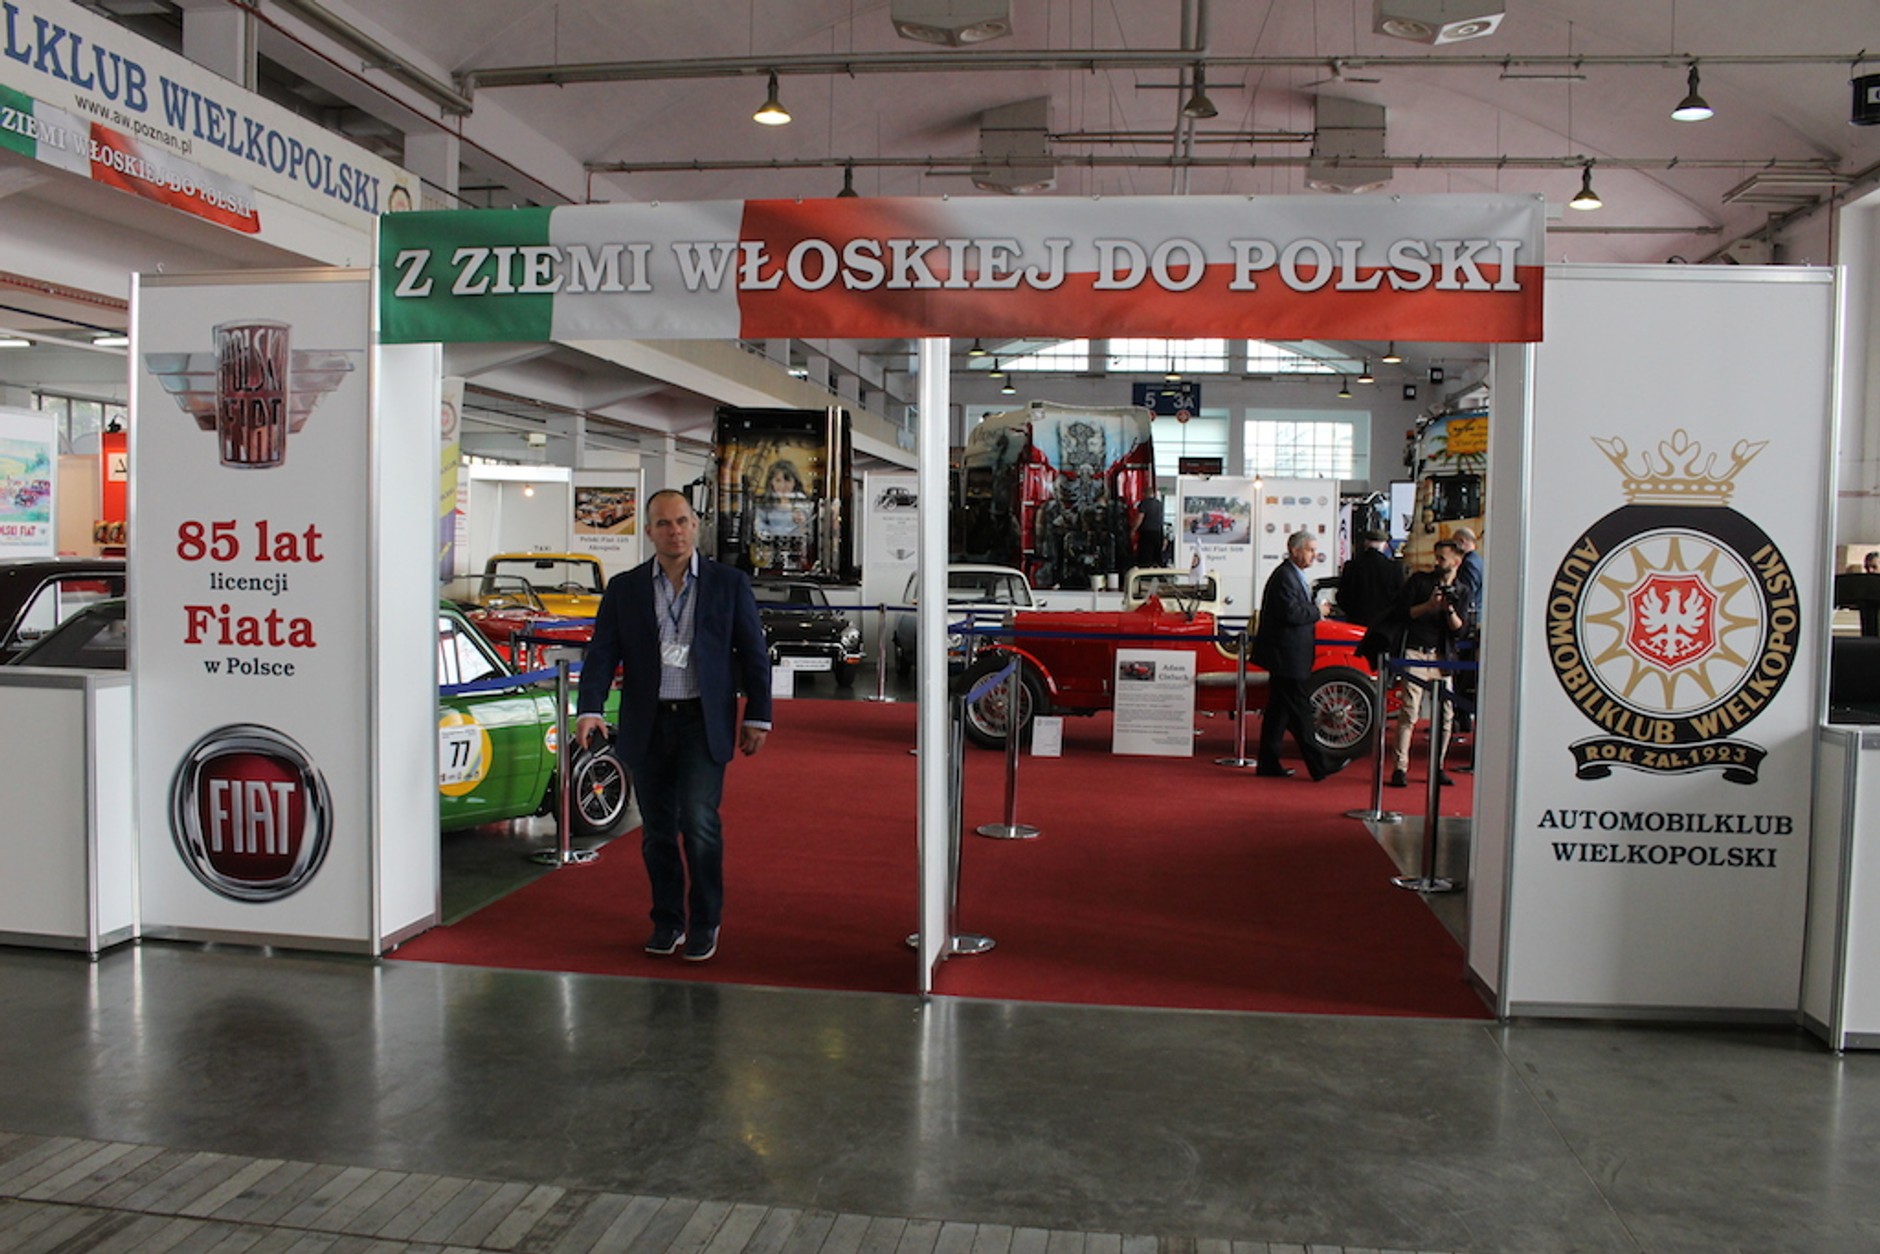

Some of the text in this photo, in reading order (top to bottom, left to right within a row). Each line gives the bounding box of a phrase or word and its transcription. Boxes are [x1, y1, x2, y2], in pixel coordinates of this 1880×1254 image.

[75, 94, 192, 154] www.aw.poznan.pl
[159, 75, 380, 215] WIELKOPOLSKI
[1, 107, 66, 150] ZIEMI
[73, 133, 165, 187] WŁOSKIEJ
[168, 168, 196, 196] DO
[394, 238, 1522, 297] Z ZIEMI WŁOSKIEJ DO POLSKI
[1144, 392, 1156, 409] 5
[177, 520, 325, 563] 85 lat
[210, 573, 289, 597] licencji
[183, 604, 317, 648] Fiata
[1549, 536, 1797, 744] AUTOMOBILKLUB WIELKOPOLSKI
[204, 657, 296, 677] w Polsce
[450, 740, 470, 768] 77
[1585, 744, 1634, 763] ROK
[209, 778, 296, 855] FIAT
[1537, 809, 1794, 836] AUTOMOBILKLUB
[1552, 842, 1778, 869] WIELKOPOLSKI
